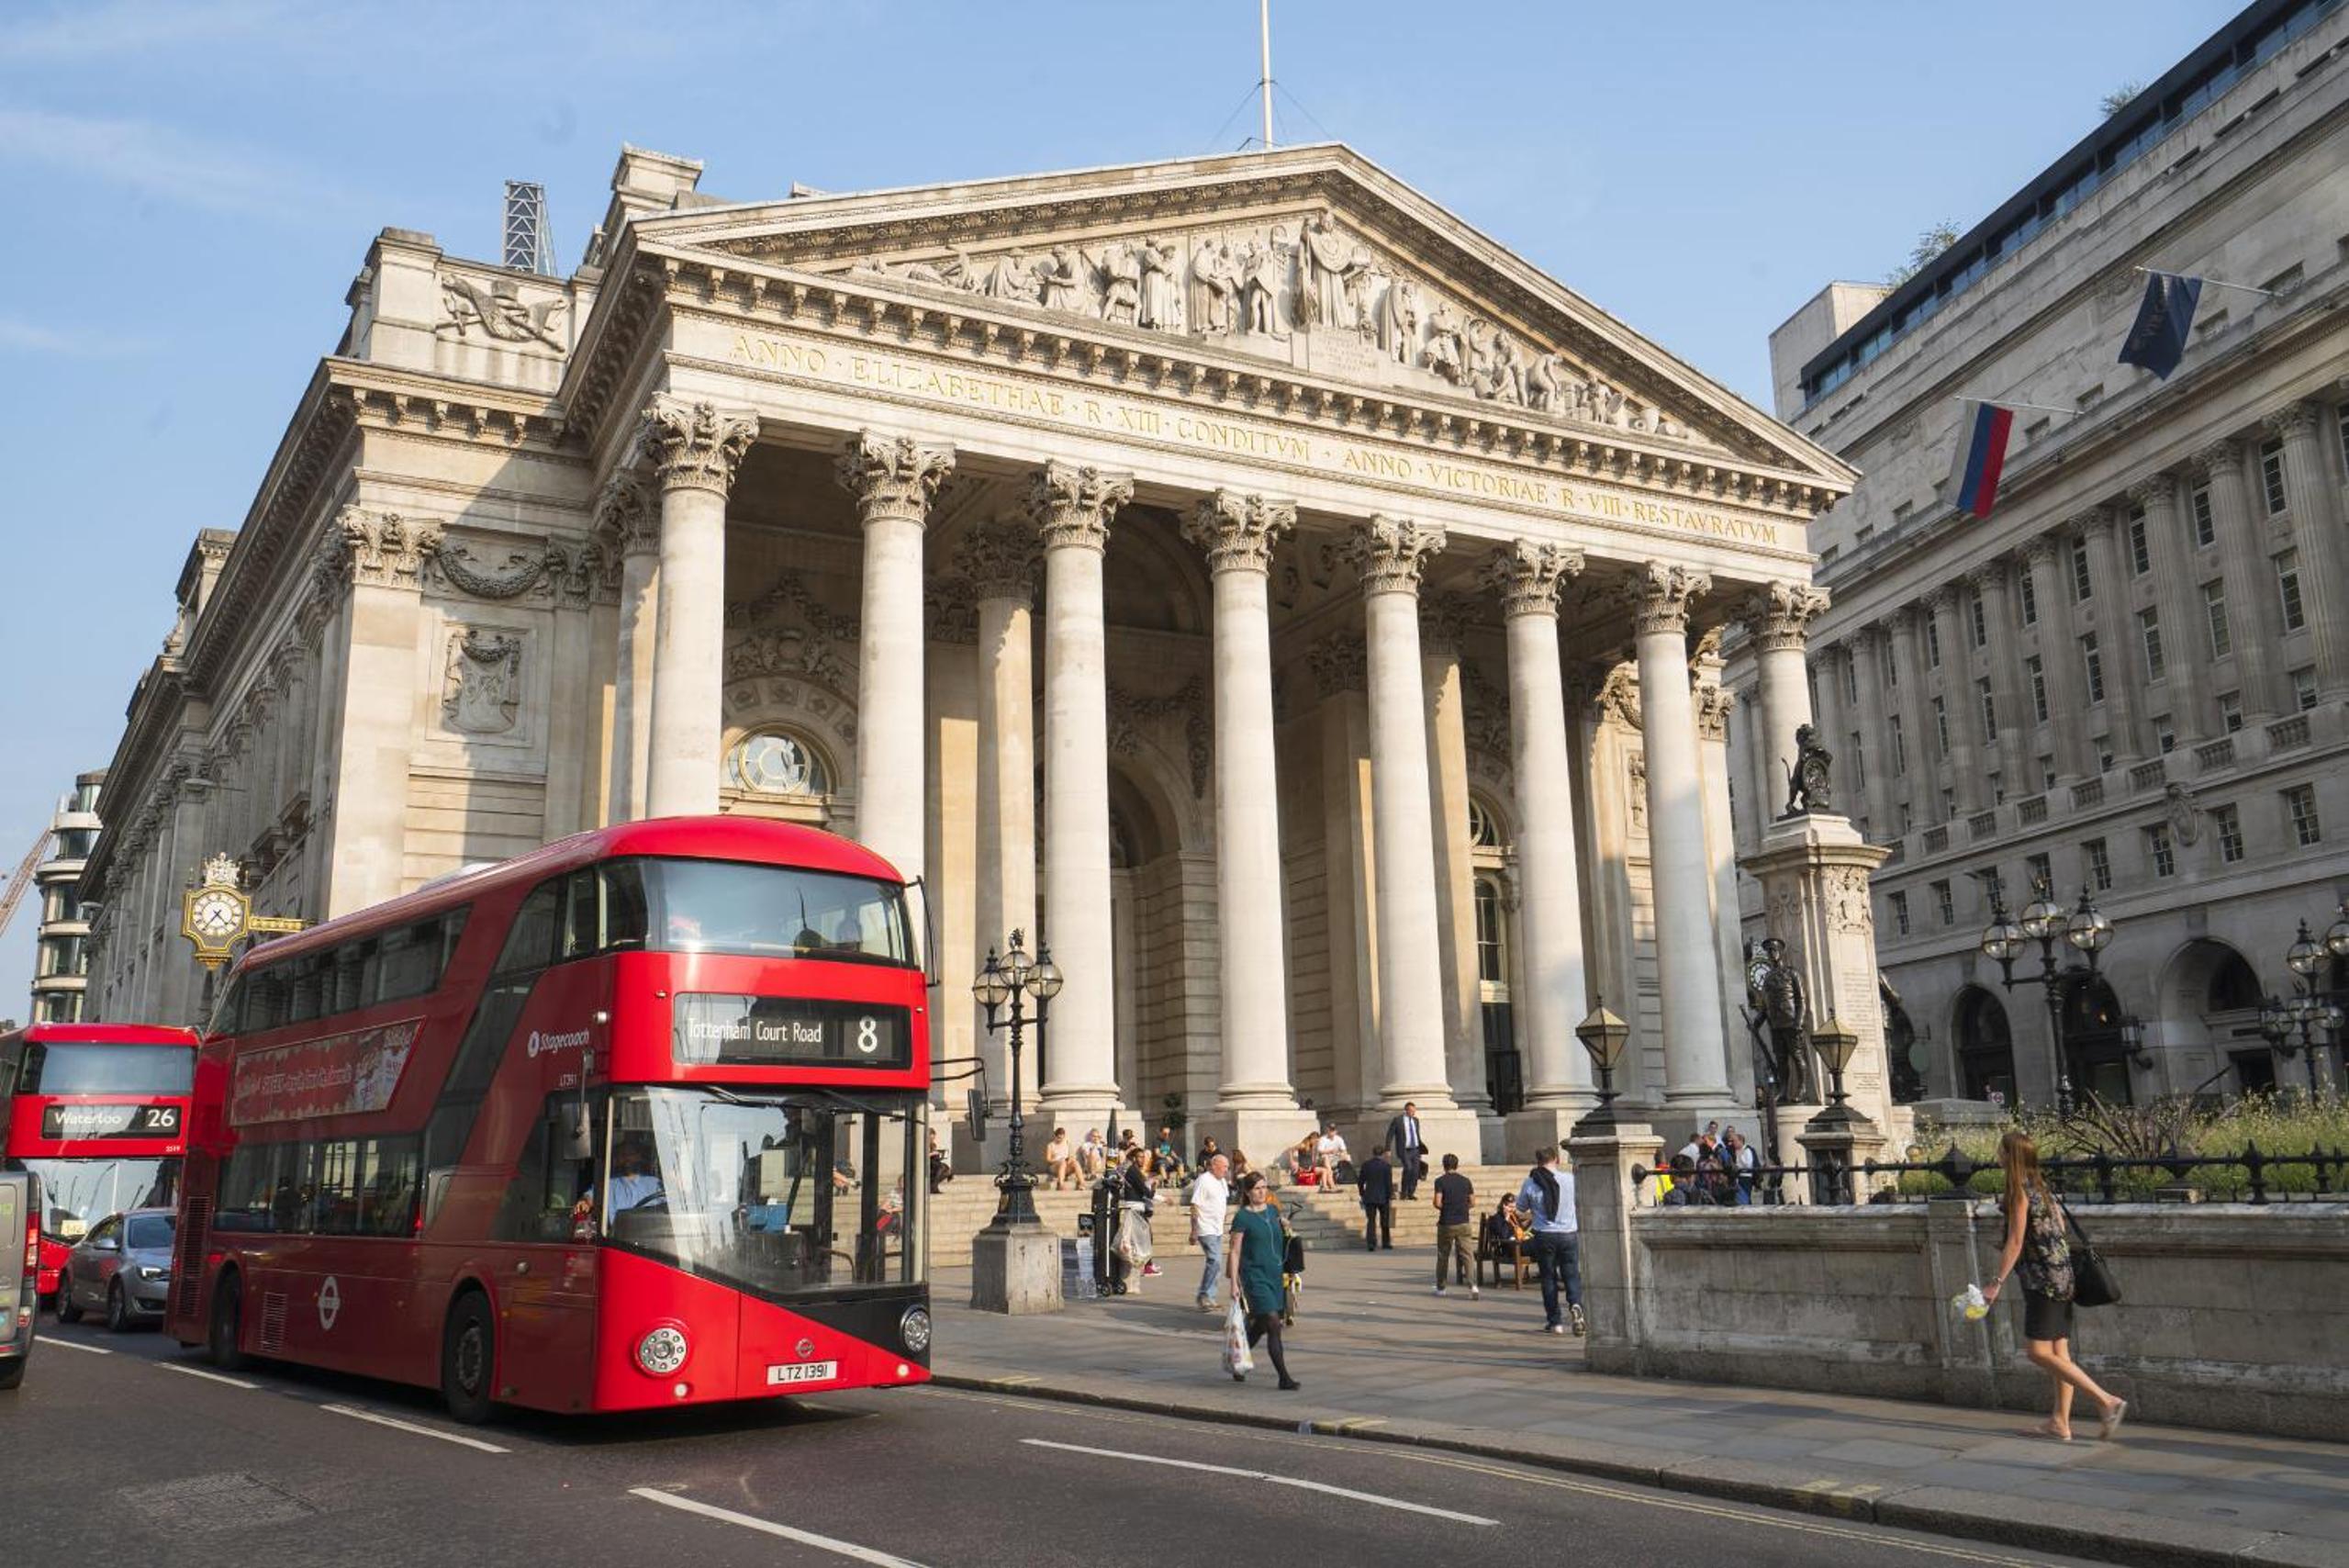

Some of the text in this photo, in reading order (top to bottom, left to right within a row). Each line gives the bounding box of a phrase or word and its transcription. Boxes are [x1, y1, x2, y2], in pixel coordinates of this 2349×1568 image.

[731, 336, 1778, 544] ANNO ELIZABETHAE R XIII CONDITVM ANNO VICTORIAE R VIII RESTAVRATVM
[540, 1028, 589, 1054] Stagecoach
[688, 1015, 878, 1053] Tottenham Court Road 8
[53, 1108, 175, 1127] Waterloo 26
[777, 1364, 828, 1381] LTZ 1391
